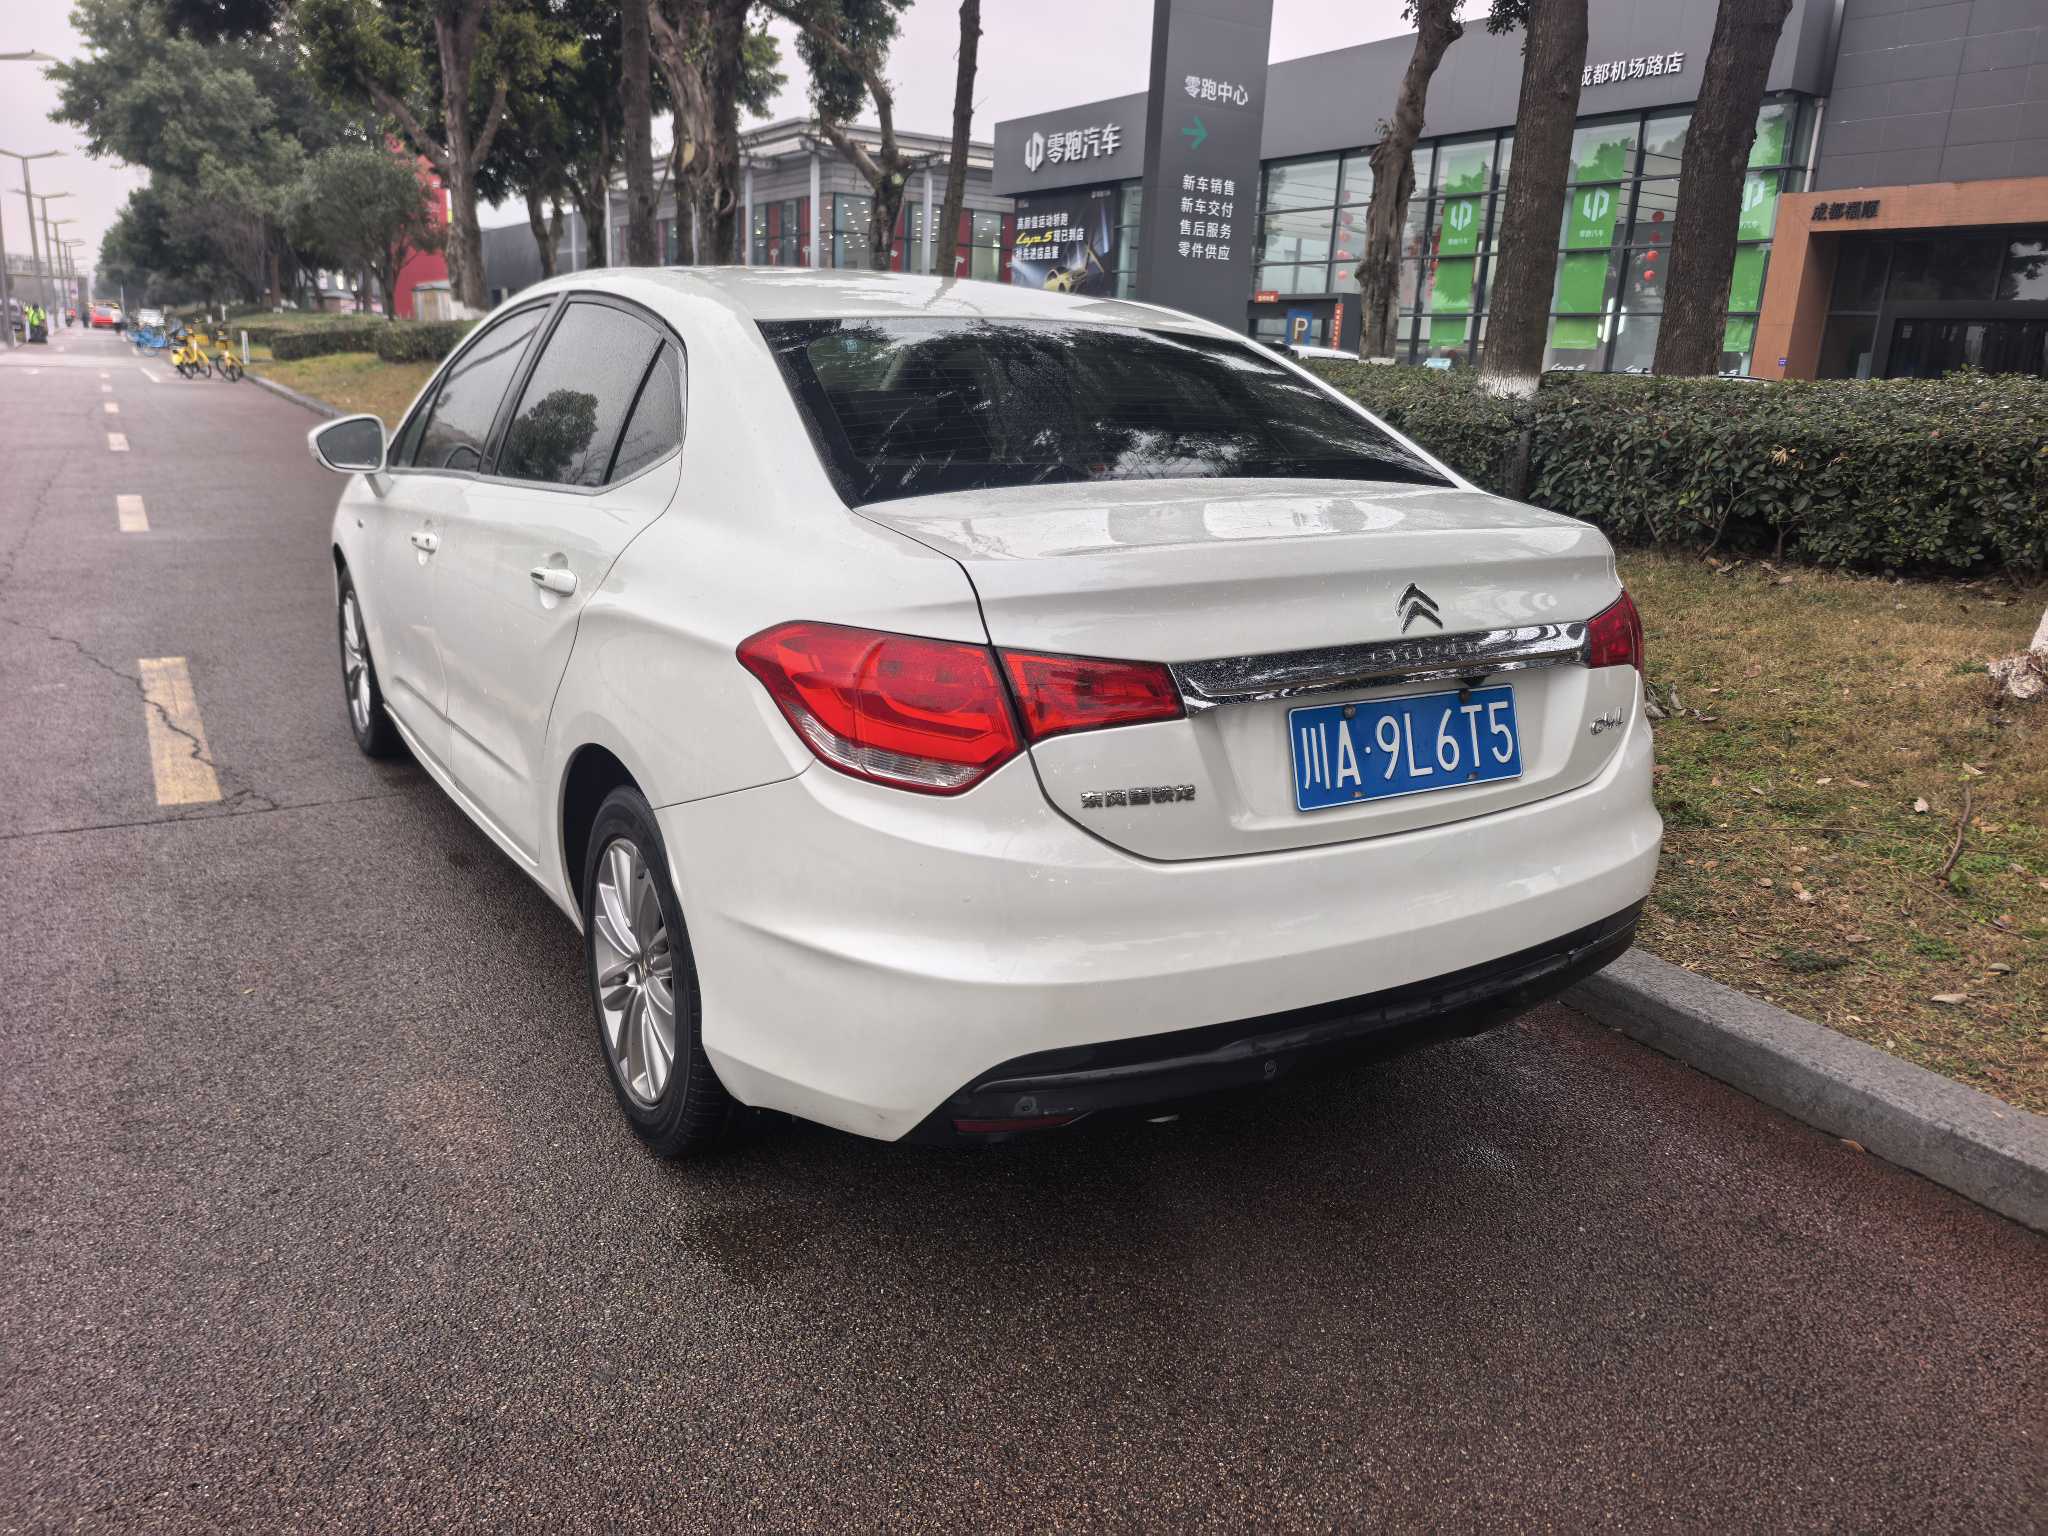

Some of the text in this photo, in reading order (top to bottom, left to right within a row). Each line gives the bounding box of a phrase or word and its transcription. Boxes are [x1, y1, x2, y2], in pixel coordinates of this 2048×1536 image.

[1184, 75, 1248, 105] 零跑中心
[1047, 123, 1121, 164] 零跑汽车
[1182, 174, 1235, 196] 新车销售
[1181, 197, 1233, 218] 新车交付
[1180, 219, 1231, 239] 售后服务
[1178, 241, 1230, 261] 零件供应
[1294, 317, 1308, 340] P
[1301, 701, 1512, 790] 川A·9L6T5
